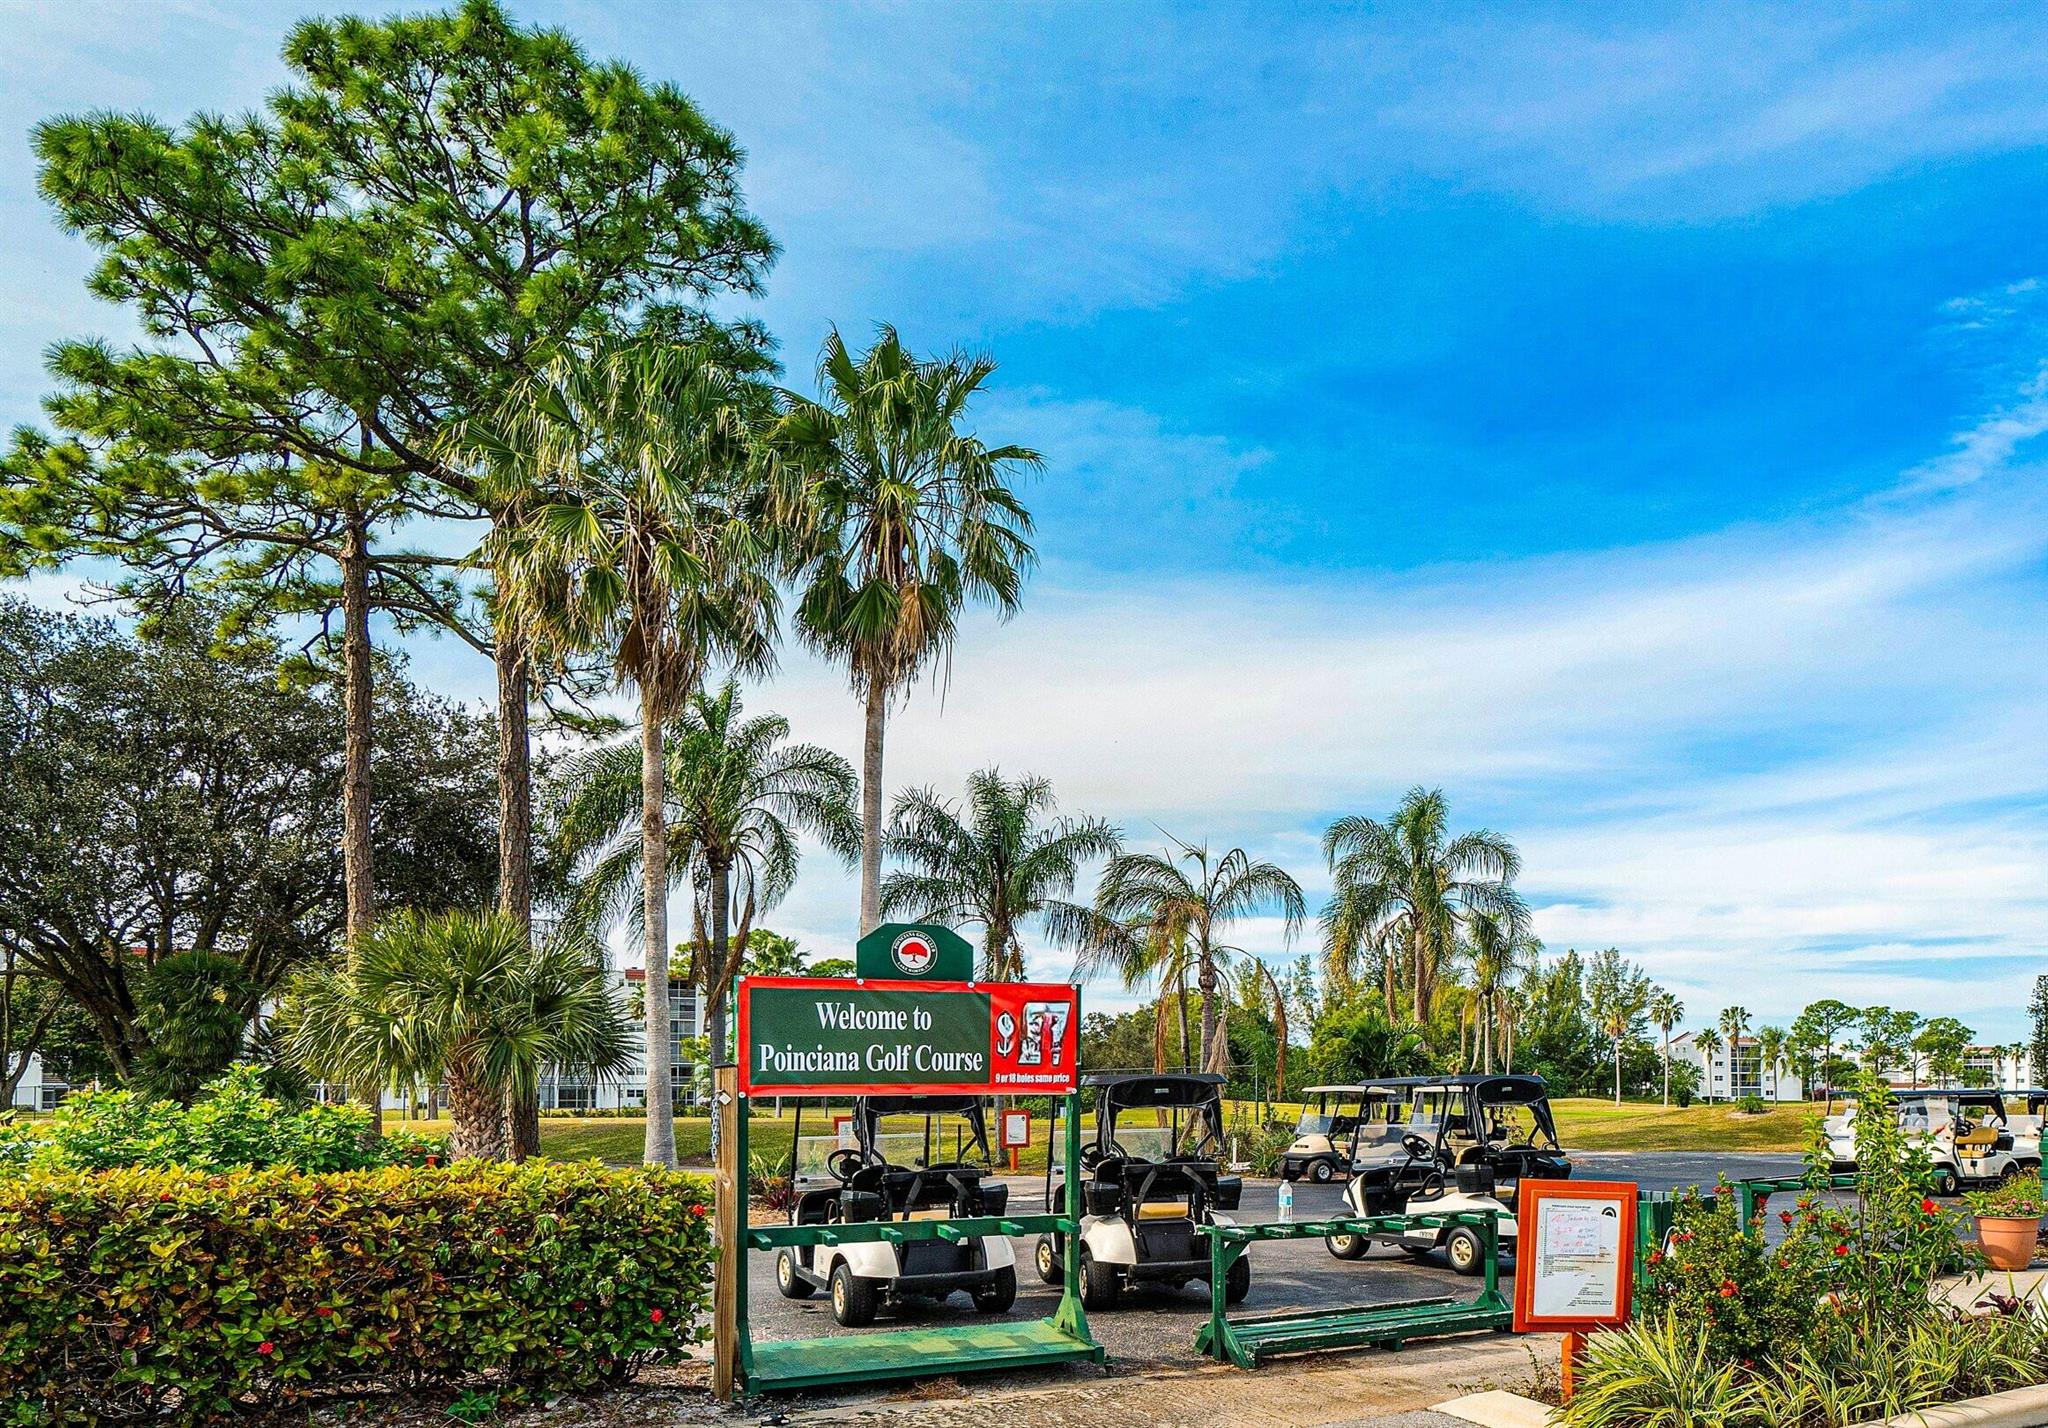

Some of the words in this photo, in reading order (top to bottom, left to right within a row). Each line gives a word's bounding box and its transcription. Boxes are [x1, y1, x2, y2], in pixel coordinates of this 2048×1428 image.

[815, 1002, 908, 1030] Welcome
[913, 1005, 932, 1030] to
[758, 1043, 860, 1072] Poinciana
[866, 1044, 911, 1072] Golf
[915, 1044, 983, 1072] Course
[995, 1073, 1001, 1083] 9
[1001, 1074, 1008, 1083] or
[1009, 1073, 1016, 1083] 18
[1017, 1073, 1035, 1083] holes
[1035, 1074, 1053, 1083] same
[1053, 1073, 1070, 1084] price
